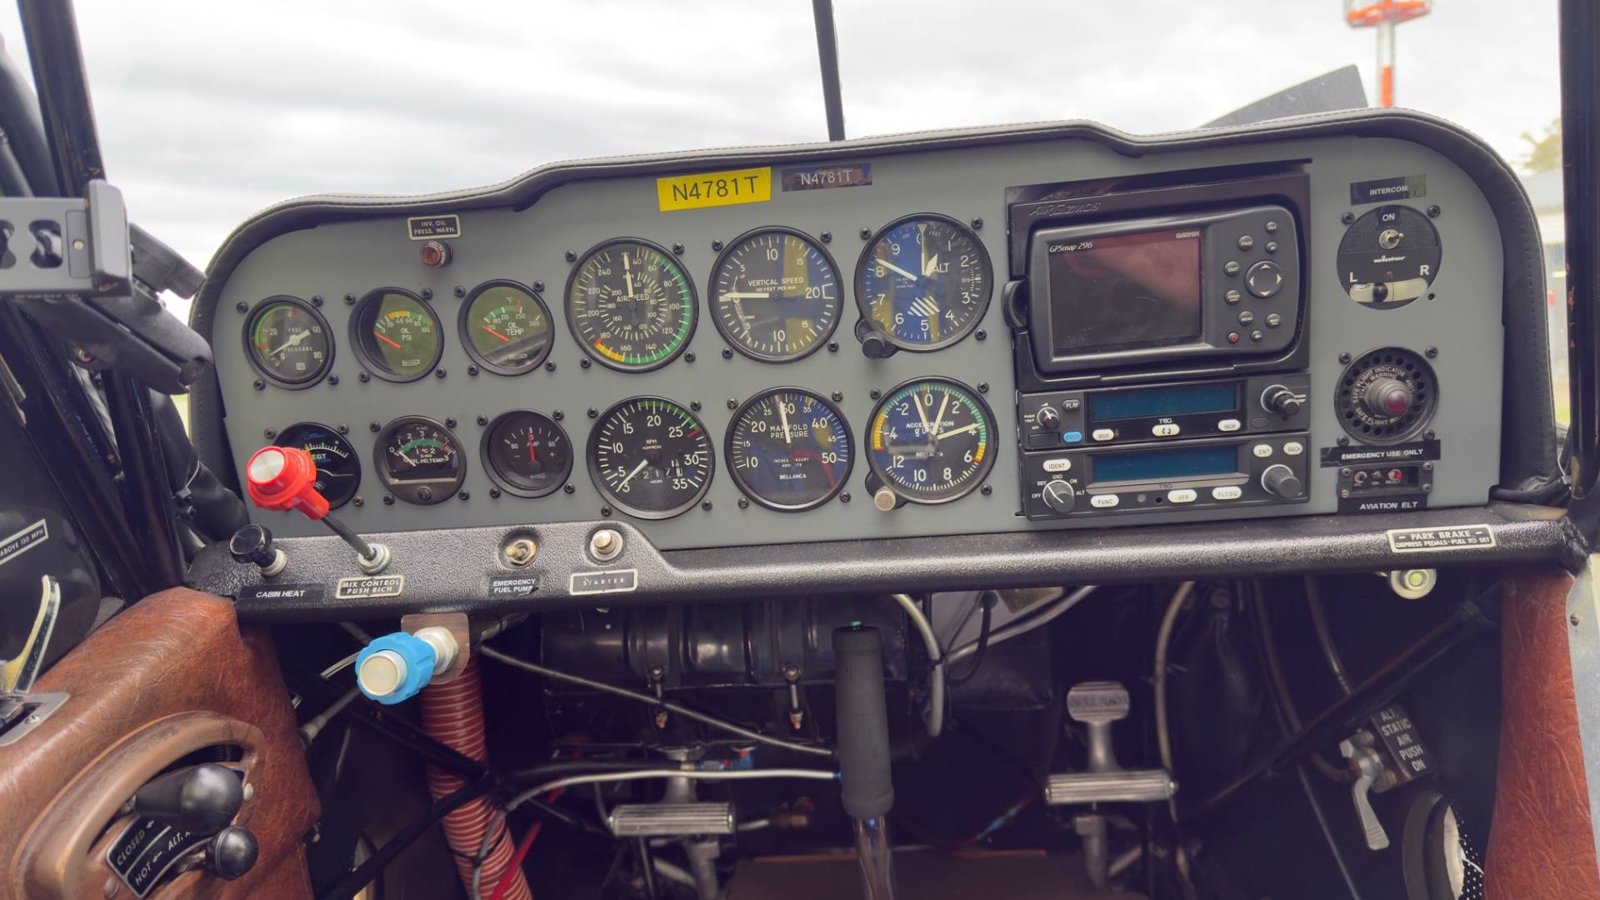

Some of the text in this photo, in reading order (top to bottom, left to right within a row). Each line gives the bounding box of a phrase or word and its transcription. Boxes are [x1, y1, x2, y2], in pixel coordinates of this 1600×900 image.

[800, 170, 852, 185] N4781T
[672, 176, 759, 202] N4781T
[1370, 185, 1408, 196] INTERCOM
[1383, 213, 1395, 221] ON
[891, 243, 900, 255] 9
[1078, 242, 1093, 250] 296
[766, 248, 778, 260] 10
[960, 255, 970, 267] 2
[875, 266, 885, 278] 8
[1420, 264, 1429, 275] R
[748, 276, 804, 287] VERTICAL SPEED
[1350, 272, 1357, 282] L
[805, 286, 820, 299] 20
[961, 292, 971, 304] 3
[877, 293, 886, 305] 7
[895, 313, 904, 325] 6
[945, 309, 955, 320] 4
[920, 319, 929, 331] 5
[505, 328, 525, 336] TEMP
[773, 330, 785, 342] 10
[924, 393, 933, 406] 0
[763, 408, 772, 416] 25
[952, 401, 961, 414] 2
[646, 415, 661, 427] 20
[751, 420, 766, 433] 20
[811, 417, 827, 429] 40
[623, 423, 634, 434] 15
[668, 426, 683, 438] 25
[612, 443, 623, 454] 10
[684, 454, 699, 466] 30
[821, 452, 837, 464] 50
[892, 455, 905, 468] 12
[963, 449, 973, 463] 6
[1341, 452, 1385, 460] EMERGENCY
[746, 457, 759, 468] 10
[618, 467, 626, 477] 5
[913, 469, 927, 482] 10
[943, 467, 952, 480] 8
[622, 482, 630, 493] 3
[673, 479, 688, 490] 35
[1360, 502, 1397, 510] AVIATION
[31, 528, 44, 540] MPH
[1410, 530, 1470, 540] PARK BRAKE
[361, 579, 400, 587] CONTROL
[493, 578, 537, 586] EMERGENCY
[513, 585, 533, 593] PUMP
[1381, 718, 1411, 736] STATIC
[1396, 733, 1413, 746] AIR
[1399, 744, 1423, 760] PUSH
[1411, 759, 1427, 772] ON
[116, 829, 145, 866] CLOSED
[135, 861, 151, 886] HOT
